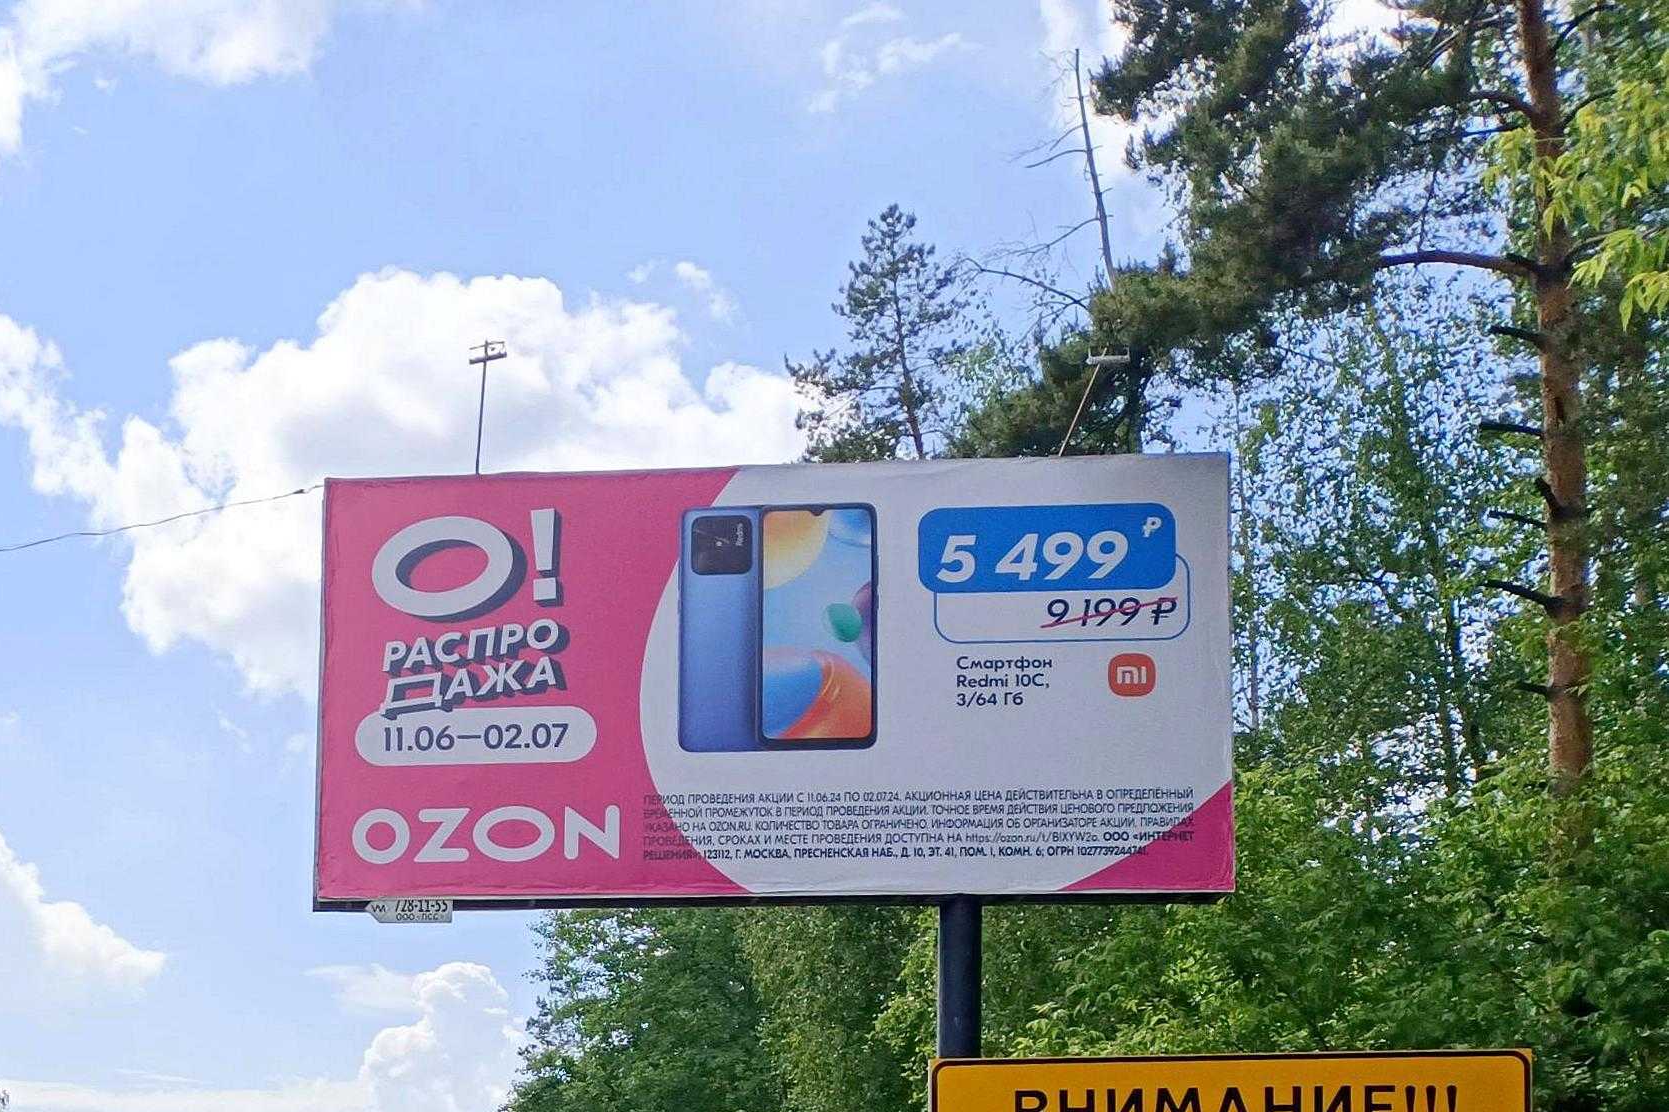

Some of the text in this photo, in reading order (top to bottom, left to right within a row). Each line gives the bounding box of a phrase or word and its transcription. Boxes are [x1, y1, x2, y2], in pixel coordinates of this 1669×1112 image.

[935, 534, 977, 583] 5
[994, 530, 1130, 581] 499
[382, 618, 561, 674] РАСПРО
[956, 655, 1053, 671] Смартфон
[380, 655, 558, 715] ДАЖА
[956, 674, 1009, 688] Redmi
[956, 691, 1024, 708] 3/64 Гб
[643, 793, 685, 806] ПЕРИОД
[687, 792, 755, 805] ПРОВЕДЕНИЯ
[758, 792, 795, 804] АКЦИИ
[796, 792, 805, 804] С
[807, 791, 841, 803] 11.06.24
[844, 791, 861, 802] ПО
[863, 791, 902, 803] 02.07.24.
[904, 790, 972, 803] АКЦИОННАЯ
[973, 790, 1003, 802] ЦЕНА
[1005, 788, 1095, 802] ДЕЙСТВИТЕЛЬНА
[1097, 789, 1104, 800] В
[705, 806, 773, 818] ПРОМЕЖУТОК
[775, 807, 782, 817] В
[784, 806, 824, 817] ПЕРИОД
[826, 805, 890, 817] ПРОВЕДЕНИЯ
[892, 804, 929, 816] АКЦИИ.
[931, 804, 970, 816] ТОЧНОЕ
[972, 803, 1005, 815] ВРЕМЯ
[1007, 802, 1058, 815] ДЕЙСТВИЯ
[1060, 803, 1116, 815] ЦЕНОВОГО
[1117, 802, 1195, 814] ПРЕДЛОЖЕНИЯ
[692, 821, 707, 832] НА
[755, 820, 821, 832] КОЛИЧЕСТВО
[822, 819, 860, 831] ТОВАРА
[861, 818, 929, 830] ОГРАНИЧЕНО.
[931, 818, 1004, 830] ИНФОРМАЦИЯ
[1006, 817, 1021, 829] ОБ
[1023, 817, 1098, 829] ОРГАНИЗАТОРЕ
[352, 805, 621, 864] OZON
[717, 835, 761, 846] СРОКАХ
[764, 835, 773, 845] И
[775, 834, 809, 845] МЕСТЕ
[811, 833, 882, 845] ПРОВЕДЕНИЯ
[884, 832, 945, 845] ДОСТУПНА
[947, 832, 963, 843] НА
[1102, 831, 1130, 842] ООО
[744, 848, 791, 860] МОСКВА,
[793, 847, 869, 859] ПРЕСНЕНСКАЯ
[959, 846, 988, 858] ПОМ.
[998, 846, 1033, 858] КОМН.
[1046, 846, 1074, 857] ОГРН
